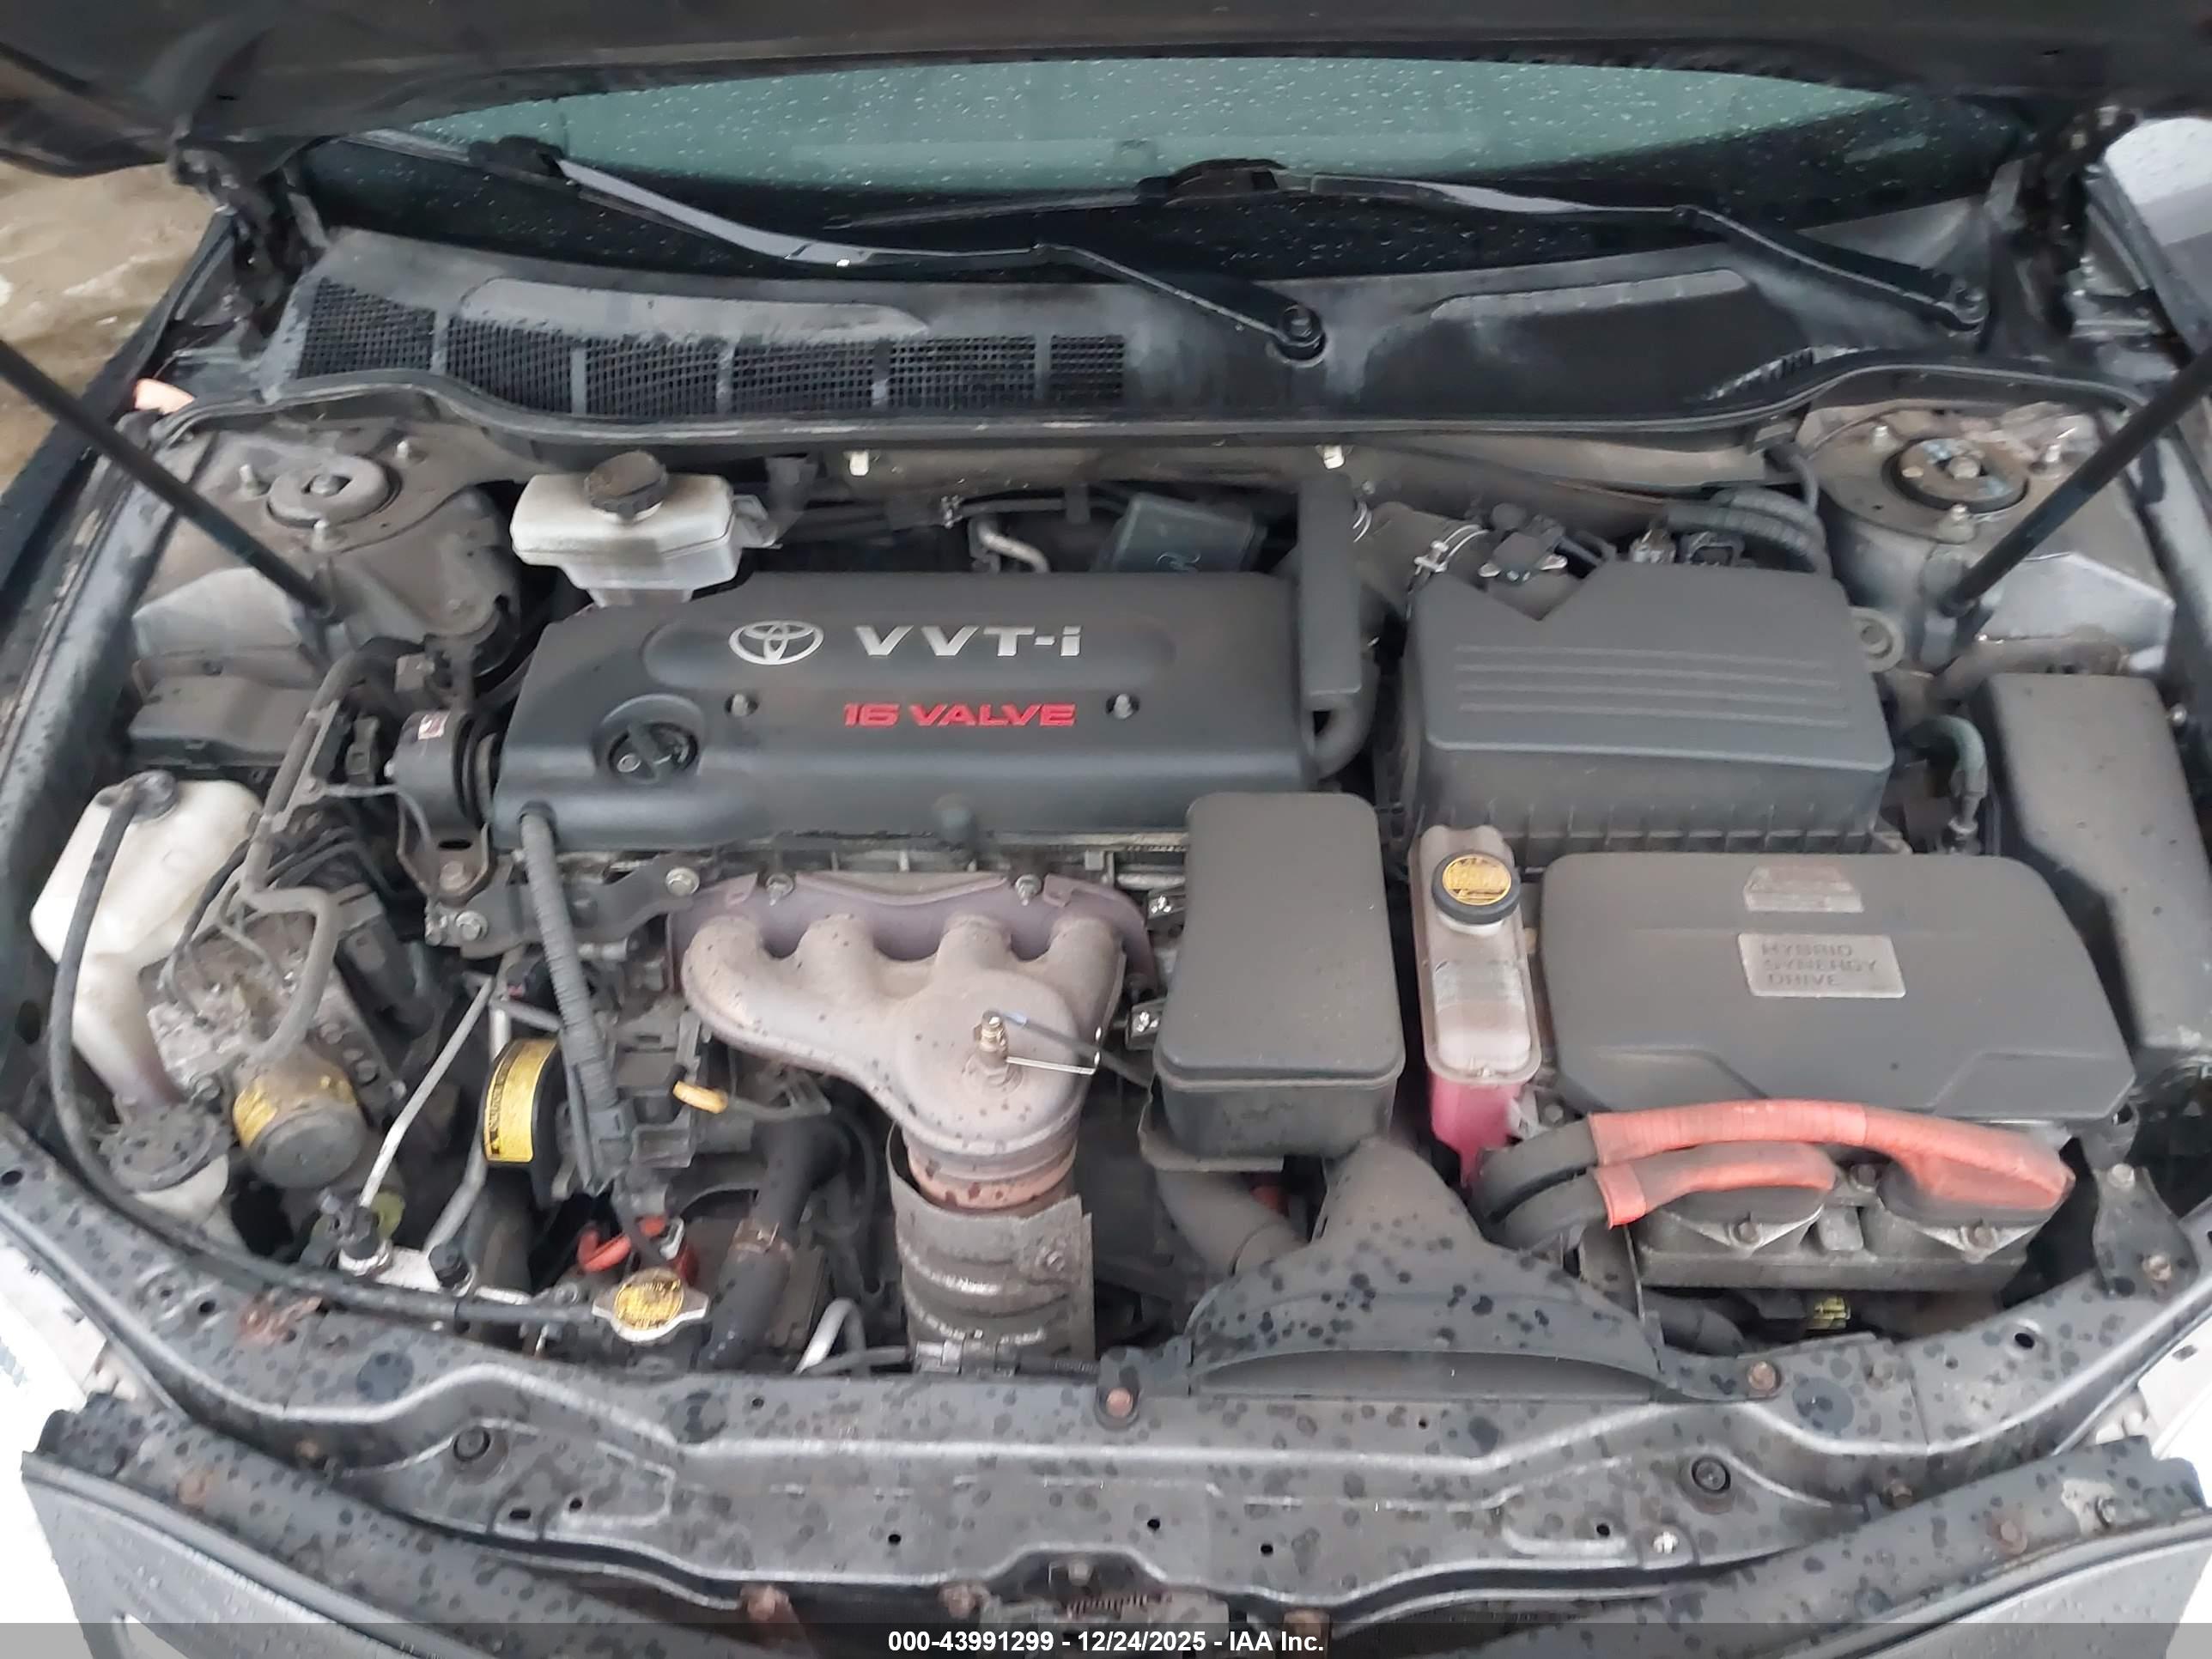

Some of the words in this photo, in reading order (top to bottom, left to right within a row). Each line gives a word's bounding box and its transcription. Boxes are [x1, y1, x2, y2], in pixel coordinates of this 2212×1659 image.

[854, 624, 1083, 657] VVT-i
[843, 702, 902, 727] 16
[908, 702, 1078, 727] VALVE
